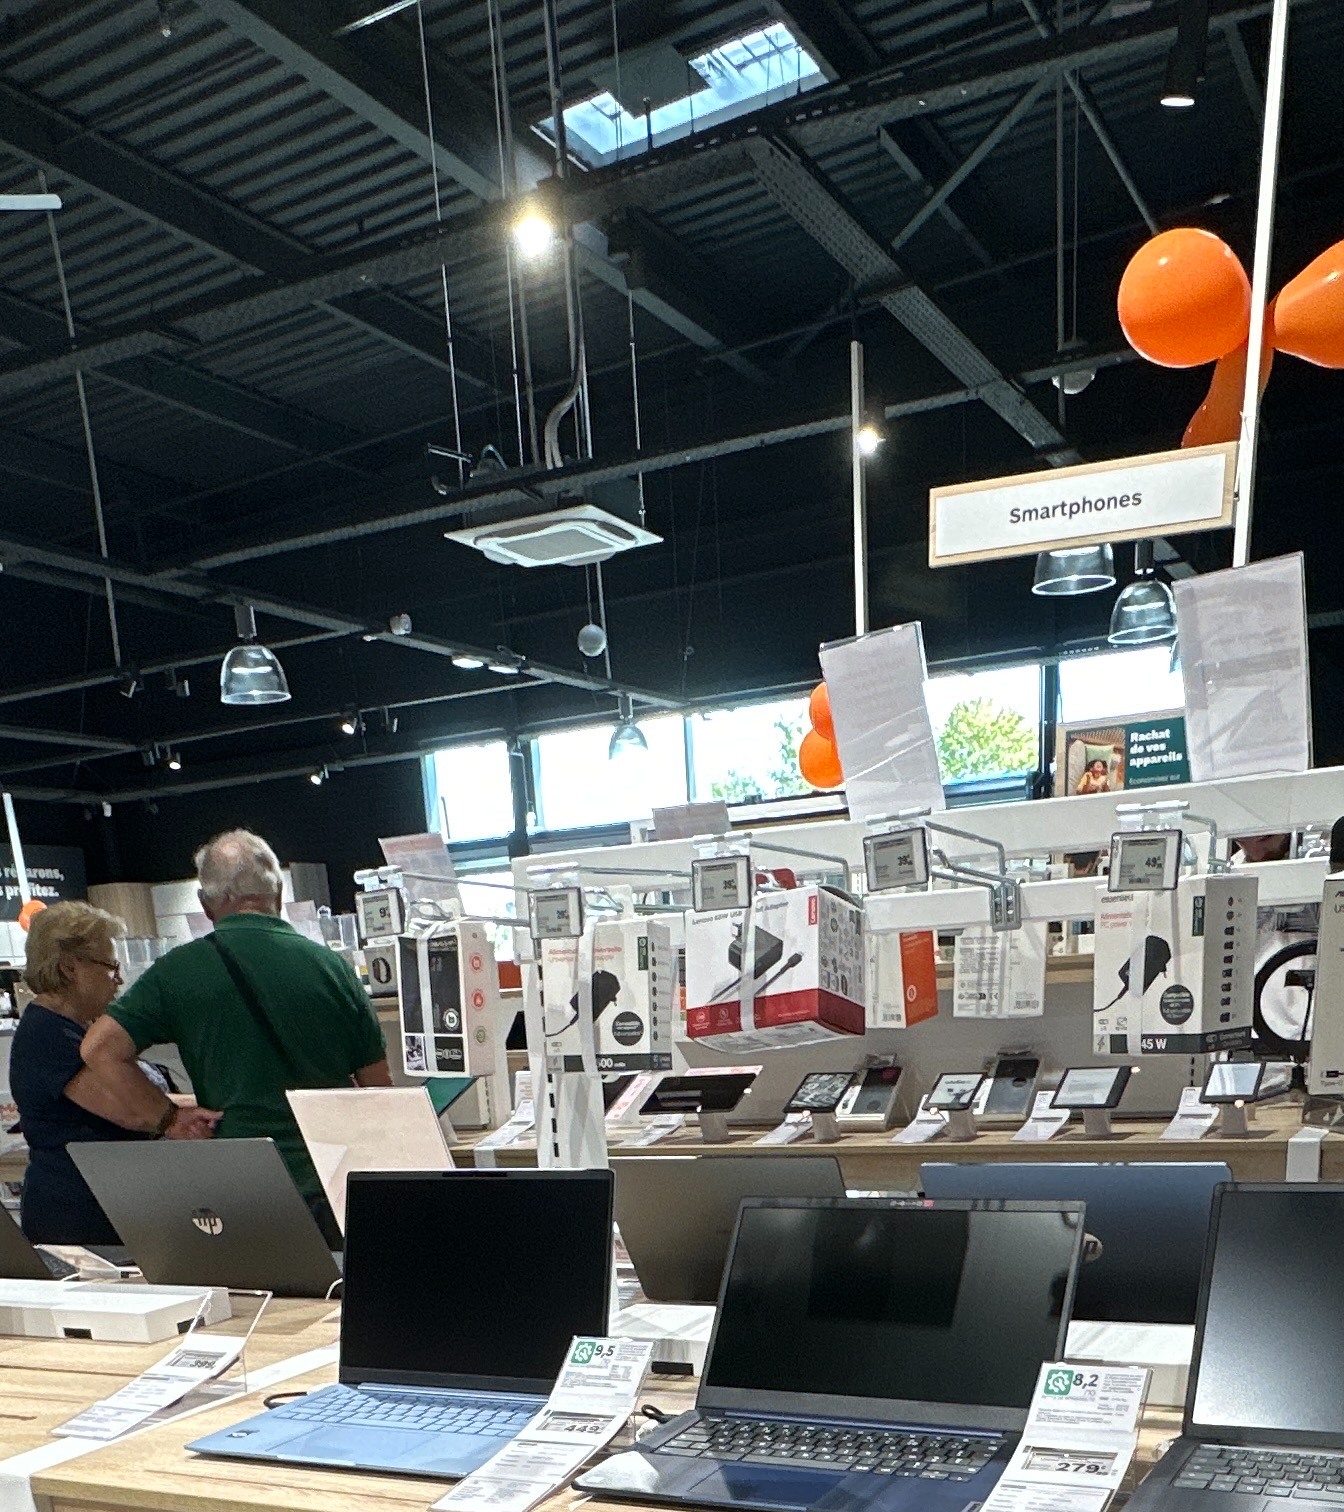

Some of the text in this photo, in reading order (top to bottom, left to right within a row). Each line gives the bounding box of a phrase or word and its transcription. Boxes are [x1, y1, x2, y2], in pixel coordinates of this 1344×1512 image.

[1009, 490, 1143, 525] Smartphones
[1130, 728, 1171, 742] Rachat
[1129, 743, 1167, 755] de vos
[1129, 751, 1183, 768] appareils
[4, 863, 65, 882] réarons,
[594, 1345, 615, 1358] 9,5
[1072, 1373, 1099, 1388] 8,2
[1056, 1462, 1100, 1474] 279
